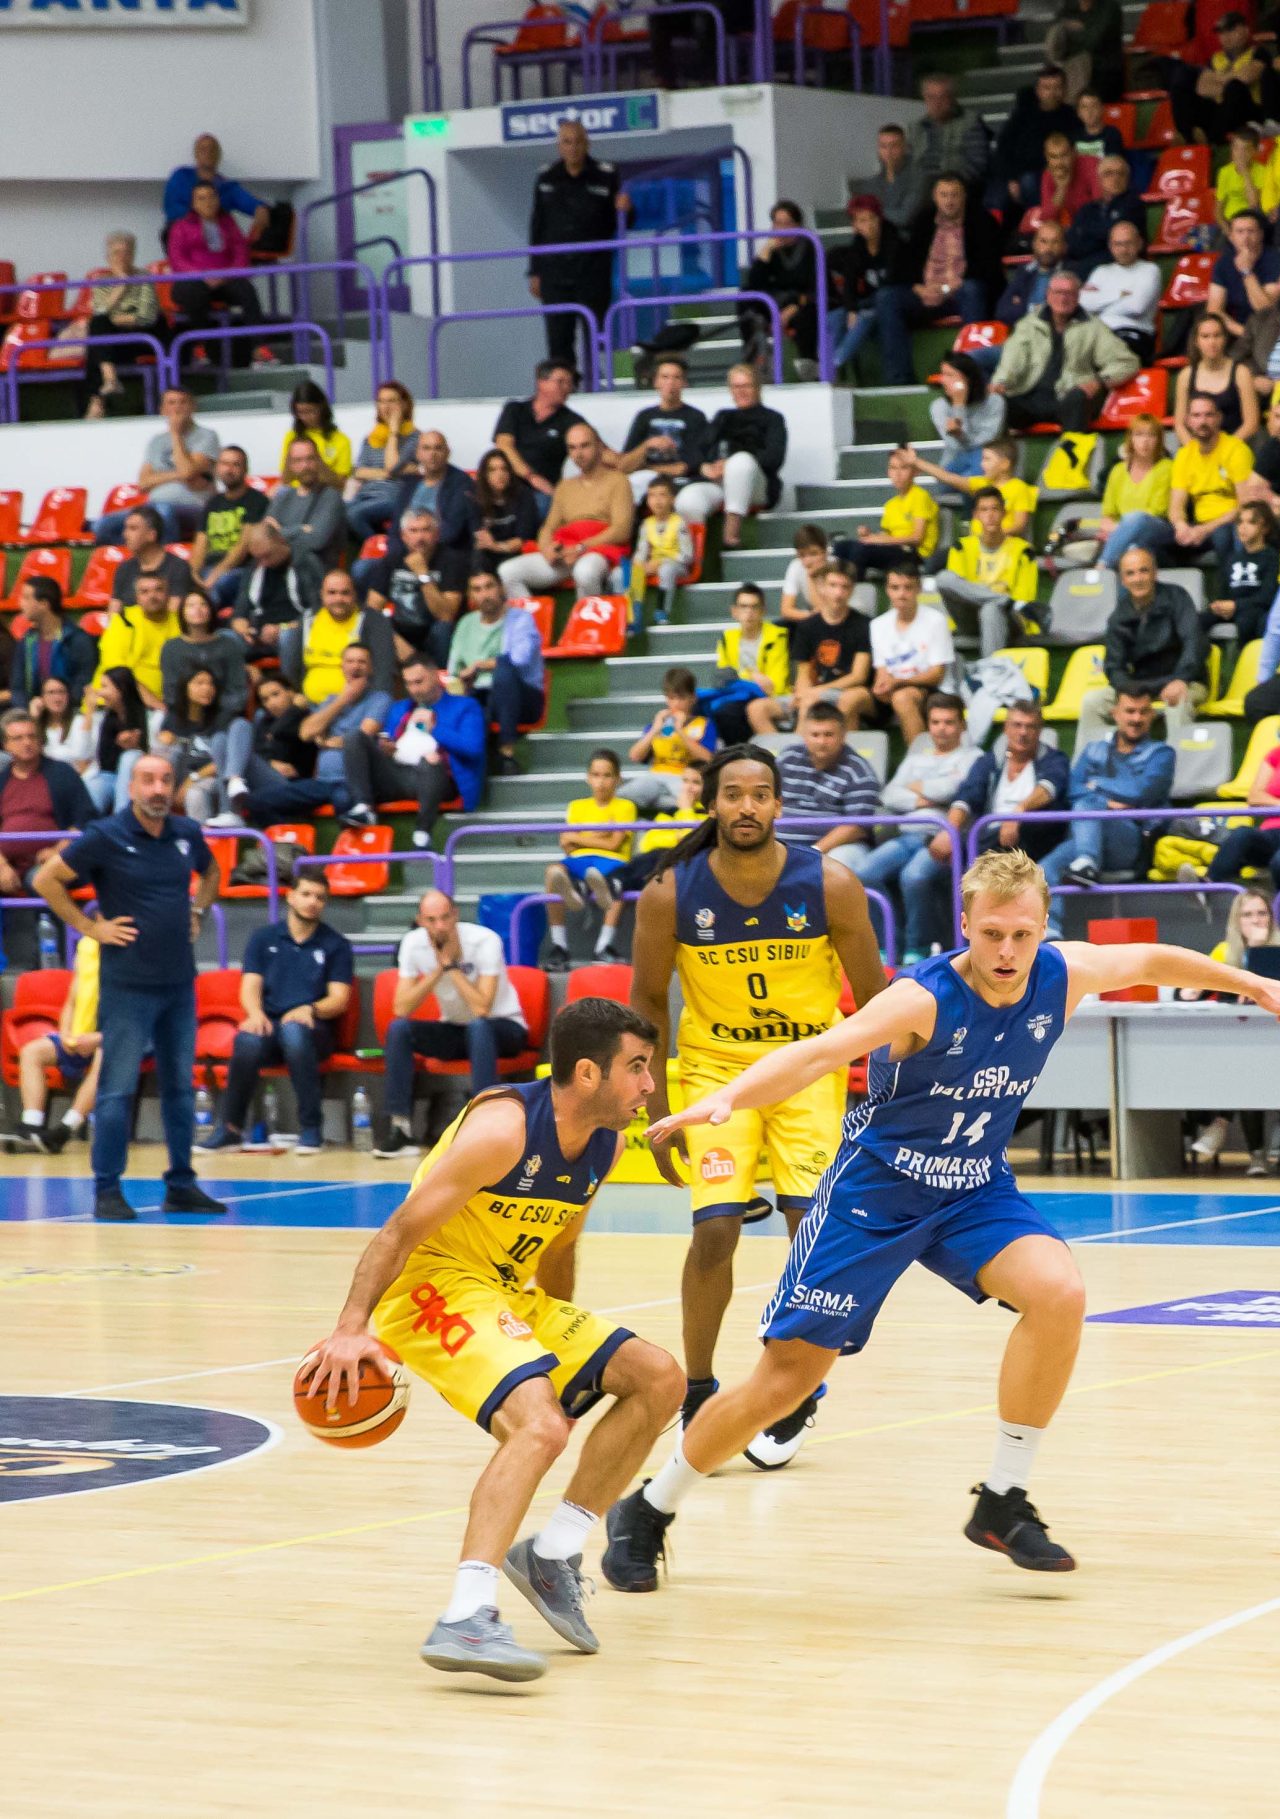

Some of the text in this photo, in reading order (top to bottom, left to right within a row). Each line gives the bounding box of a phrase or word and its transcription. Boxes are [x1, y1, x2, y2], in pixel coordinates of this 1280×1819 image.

[698, 944, 811, 965] BC CSU SIBIU
[747, 973, 768, 1000] 0
[941, 1111, 992, 1147] 14
[488, 1201, 517, 1219] BC
[520, 1205, 555, 1224] CSU
[507, 1233, 544, 1264] 10
[784, 1301, 849, 1319] MINERAL WATER
[790, 1284, 860, 1312] SIRMA
